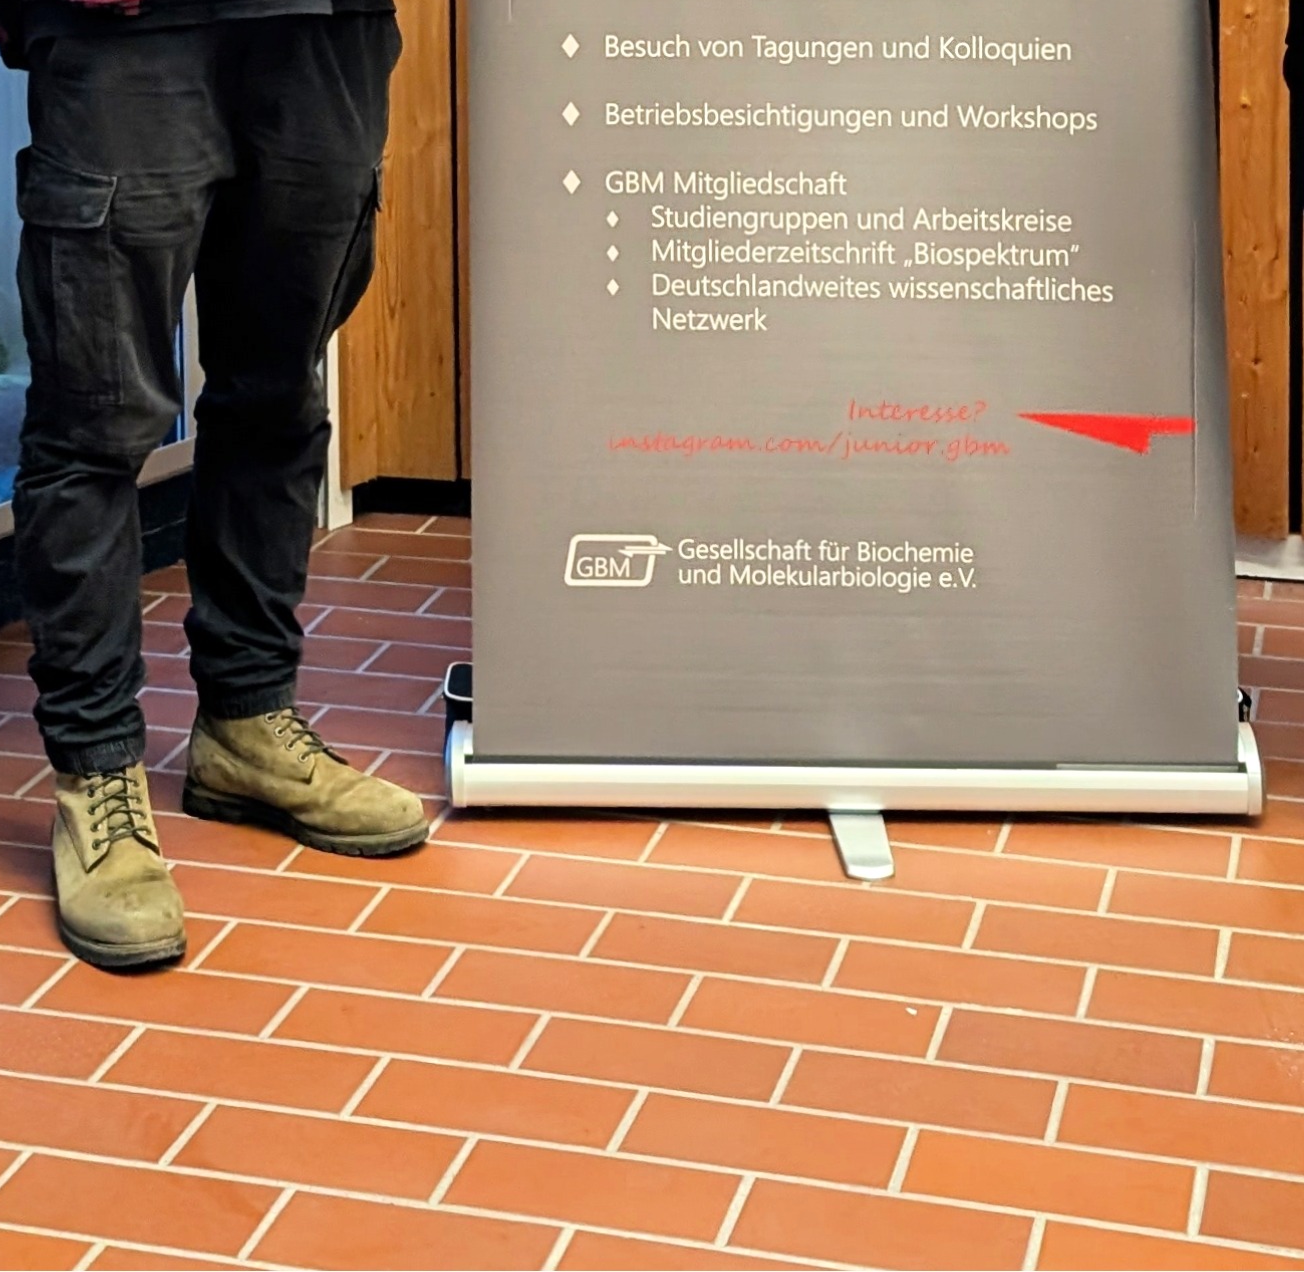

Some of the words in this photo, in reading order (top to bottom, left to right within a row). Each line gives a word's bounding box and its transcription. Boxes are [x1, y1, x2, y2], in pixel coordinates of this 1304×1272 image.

[606, 34, 689, 58] Besuch
[698, 41, 743, 58] von
[752, 36, 873, 64] Tagungen
[883, 36, 929, 59] und
[940, 36, 1072, 66] Kolloquien
[606, 102, 891, 133] Betriebsbesichtigungen
[902, 104, 947, 128] und
[957, 105, 1098, 134] Workshops
[606, 171, 663, 195] GBM
[675, 171, 847, 201] Mitgliedschaft
[652, 205, 848, 235] Studiengruppen
[857, 207, 904, 231] und
[913, 207, 1072, 233] Arbeitskreise
[652, 239, 895, 270] Mitgliederzeitschrift
[652, 274, 881, 301] Deutschlandweites
[889, 276, 1114, 303] wissenschaftliches
[652, 308, 768, 331] Netzwerk
[848, 399, 989, 424] Interesse?
[606, 431, 1012, 463] instagram.com/junior.gbm
[678, 538, 811, 563] Gesellschaft
[818, 540, 850, 562] für
[858, 541, 974, 564] Biochemie
[576, 556, 632, 580] GBM
[678, 564, 721, 586] und
[729, 565, 932, 593] Molekularbiologie
[939, 568, 977, 589] e.V.
